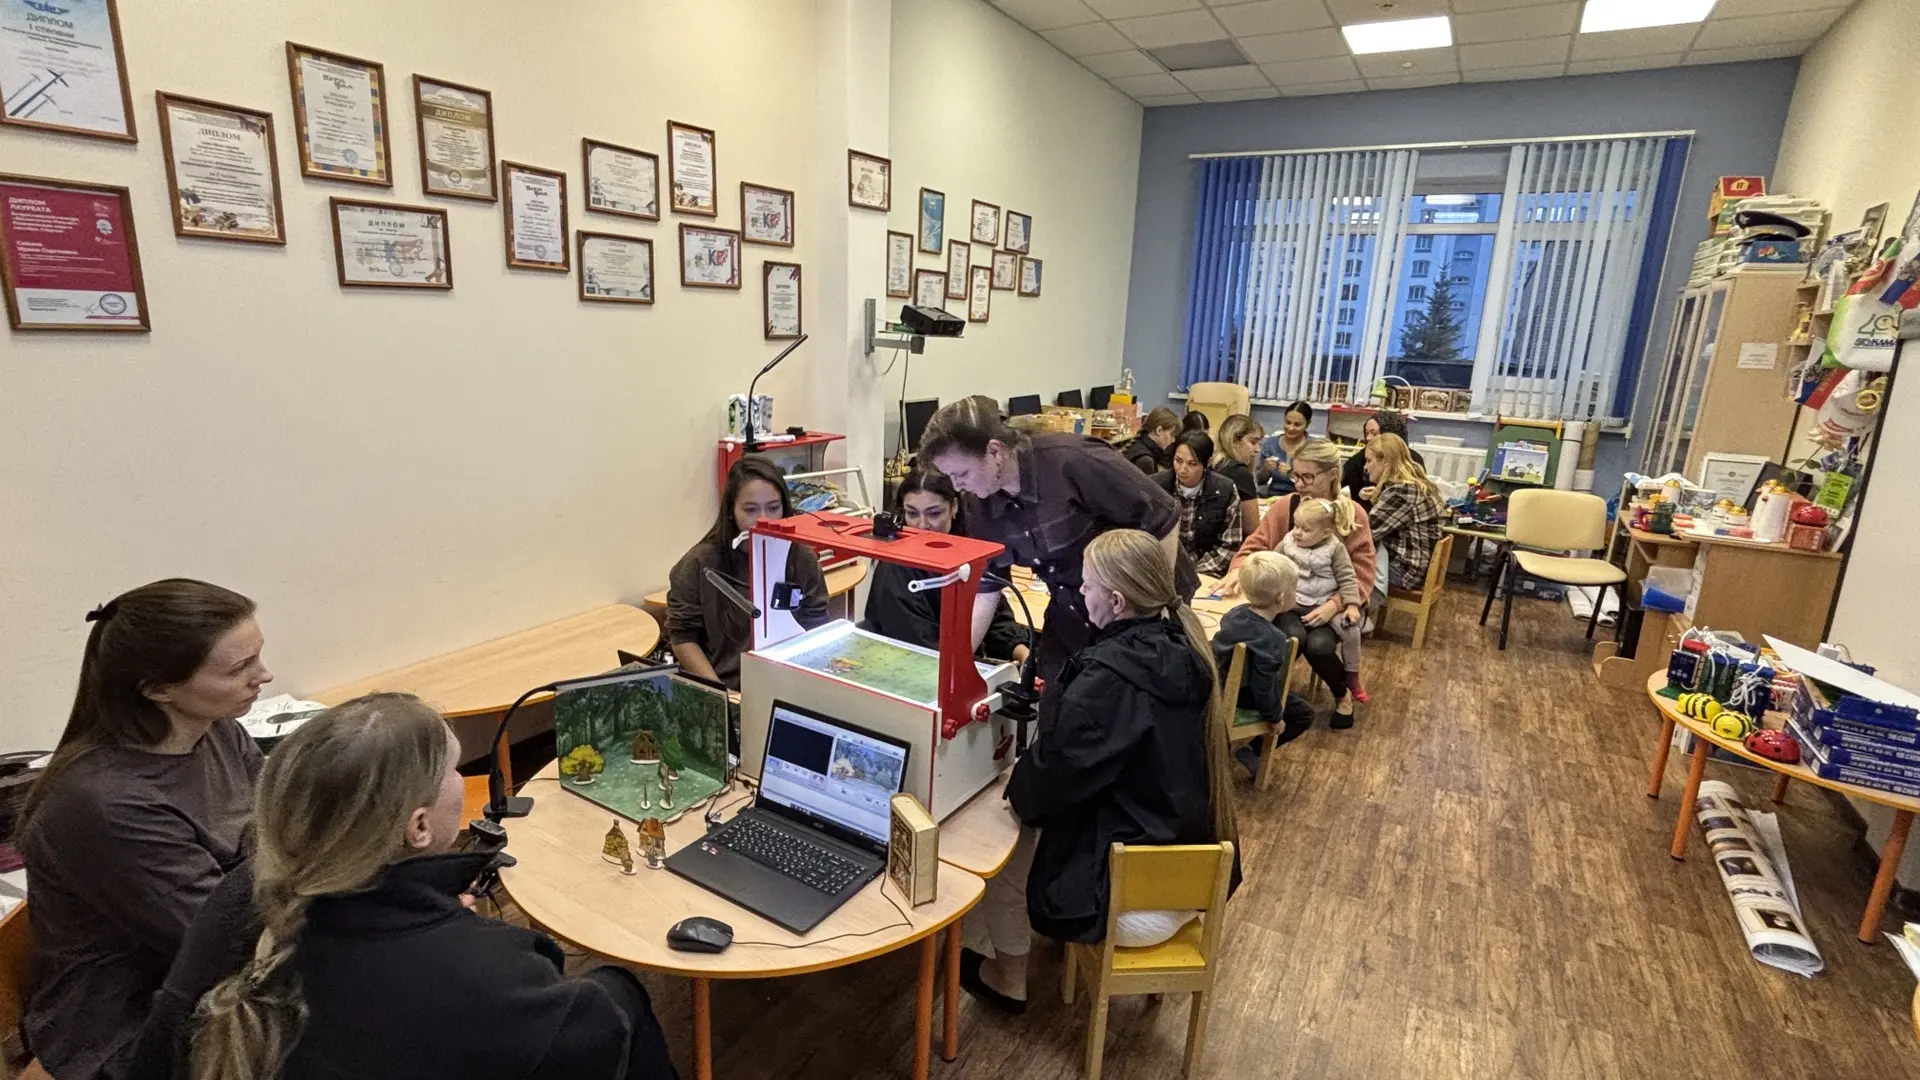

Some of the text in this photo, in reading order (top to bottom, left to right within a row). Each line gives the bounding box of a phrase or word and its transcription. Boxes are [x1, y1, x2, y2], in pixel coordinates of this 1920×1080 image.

[436, 108, 472, 120] ДИПЛОМ
[197, 127, 241, 141] ДИПЛОМ
[368, 219, 405, 229] ДИПЛОМ
